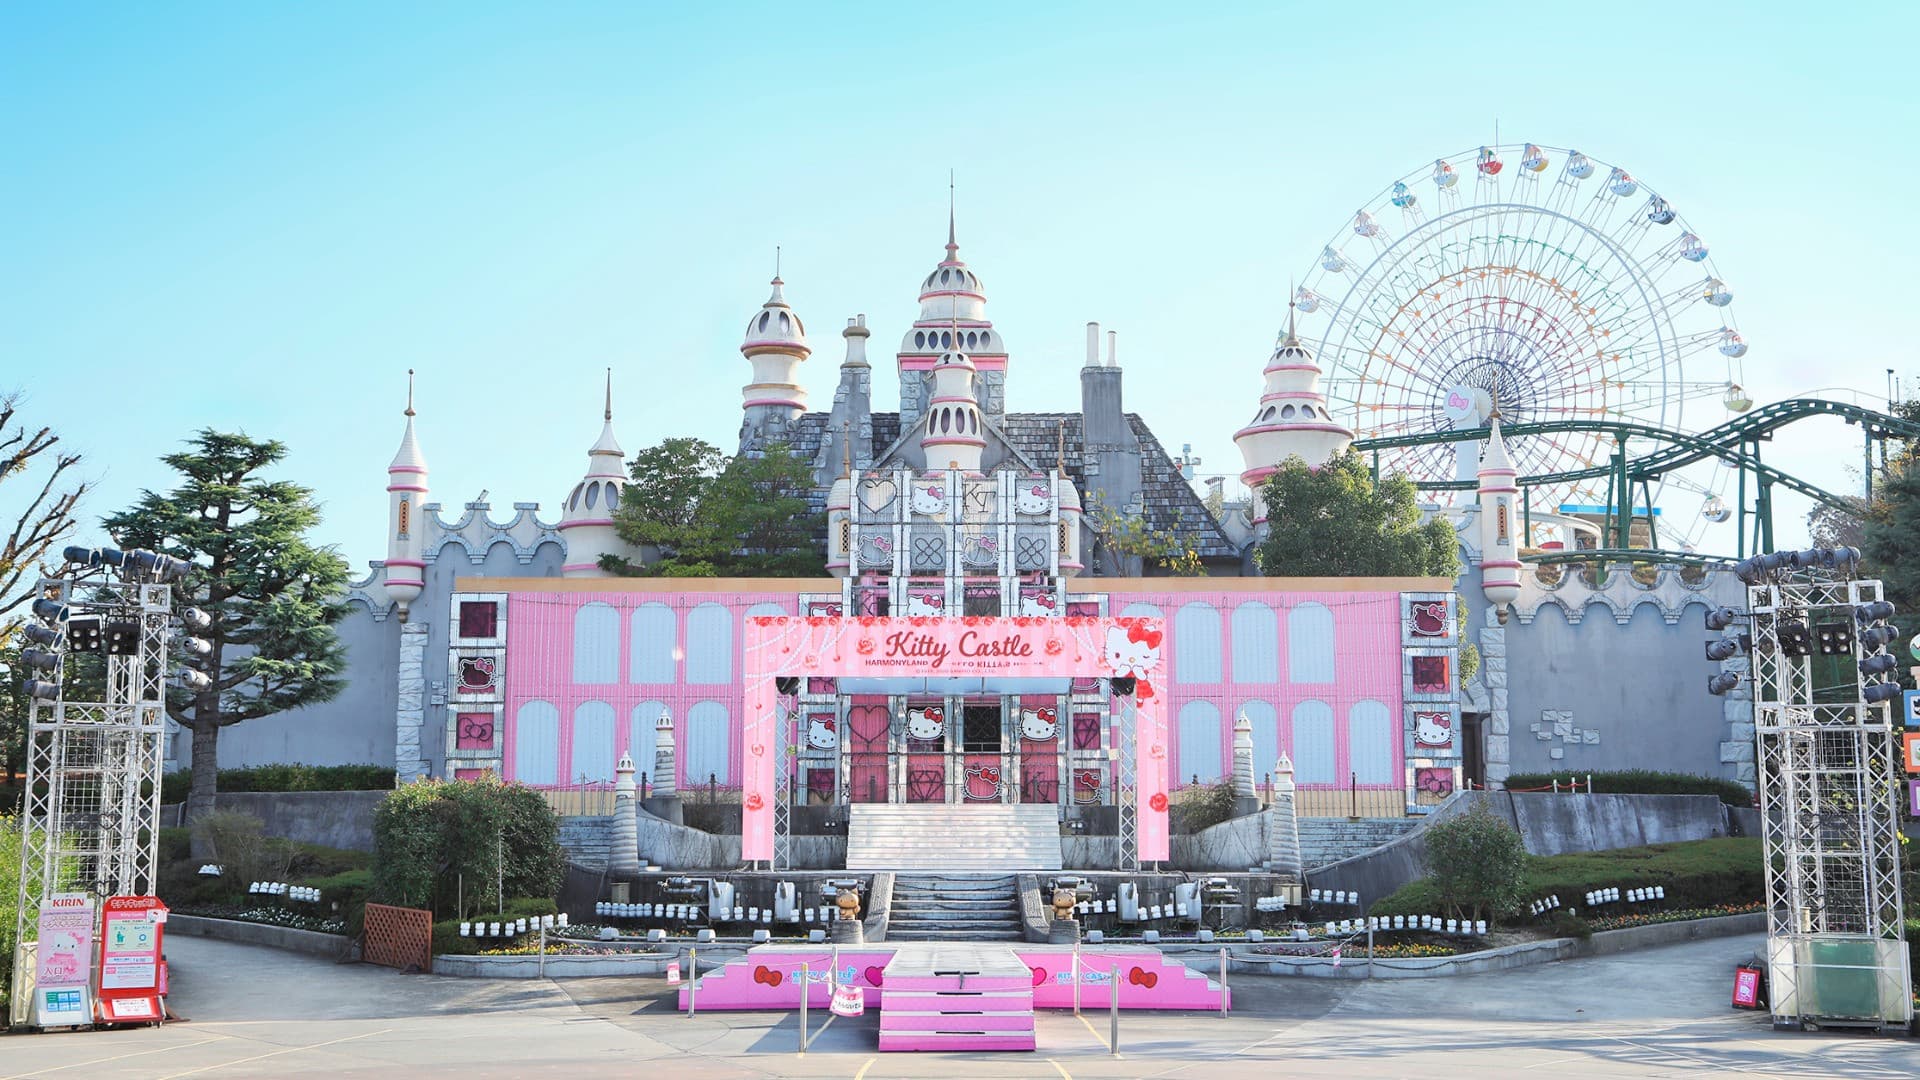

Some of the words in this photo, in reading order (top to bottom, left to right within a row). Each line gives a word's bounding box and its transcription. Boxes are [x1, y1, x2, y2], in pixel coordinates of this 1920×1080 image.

[885, 631, 950, 668] Kitty
[958, 631, 1033, 657] Castle
[865, 659, 929, 667] HARMONYLAND
[52, 898, 85, 907] KIRIN
[44, 967, 62, 975] 入口
